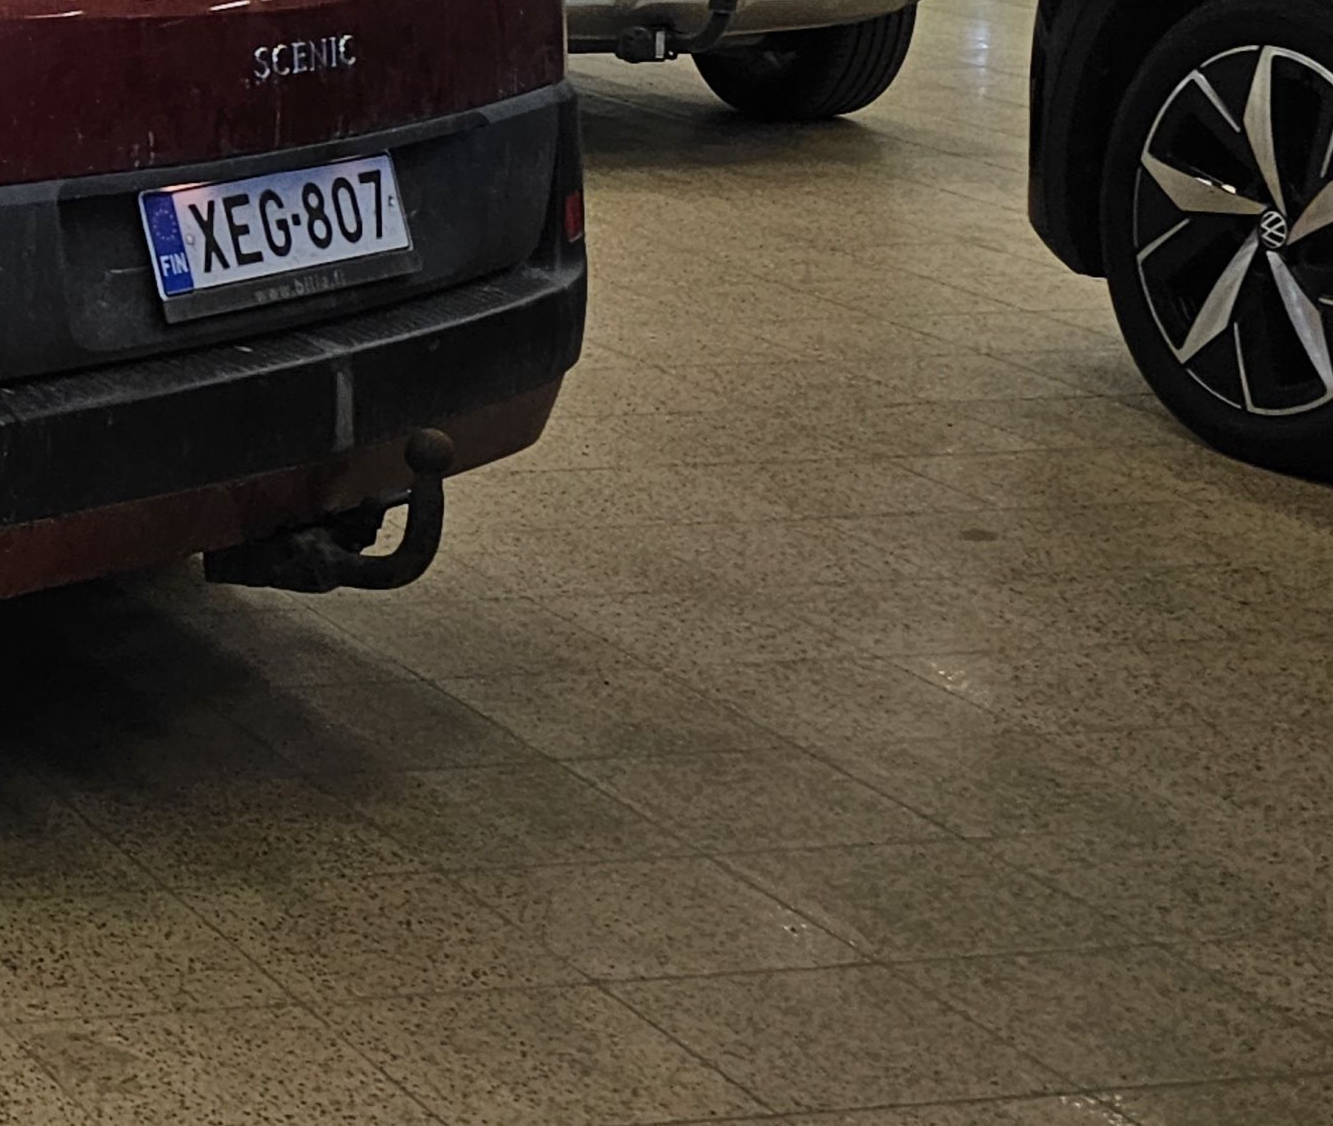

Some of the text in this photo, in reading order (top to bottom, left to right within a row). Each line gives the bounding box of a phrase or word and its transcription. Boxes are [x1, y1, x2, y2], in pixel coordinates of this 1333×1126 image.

[253, 34, 357, 79] SCENIC
[159, 169, 383, 277] FIN XEG-807
